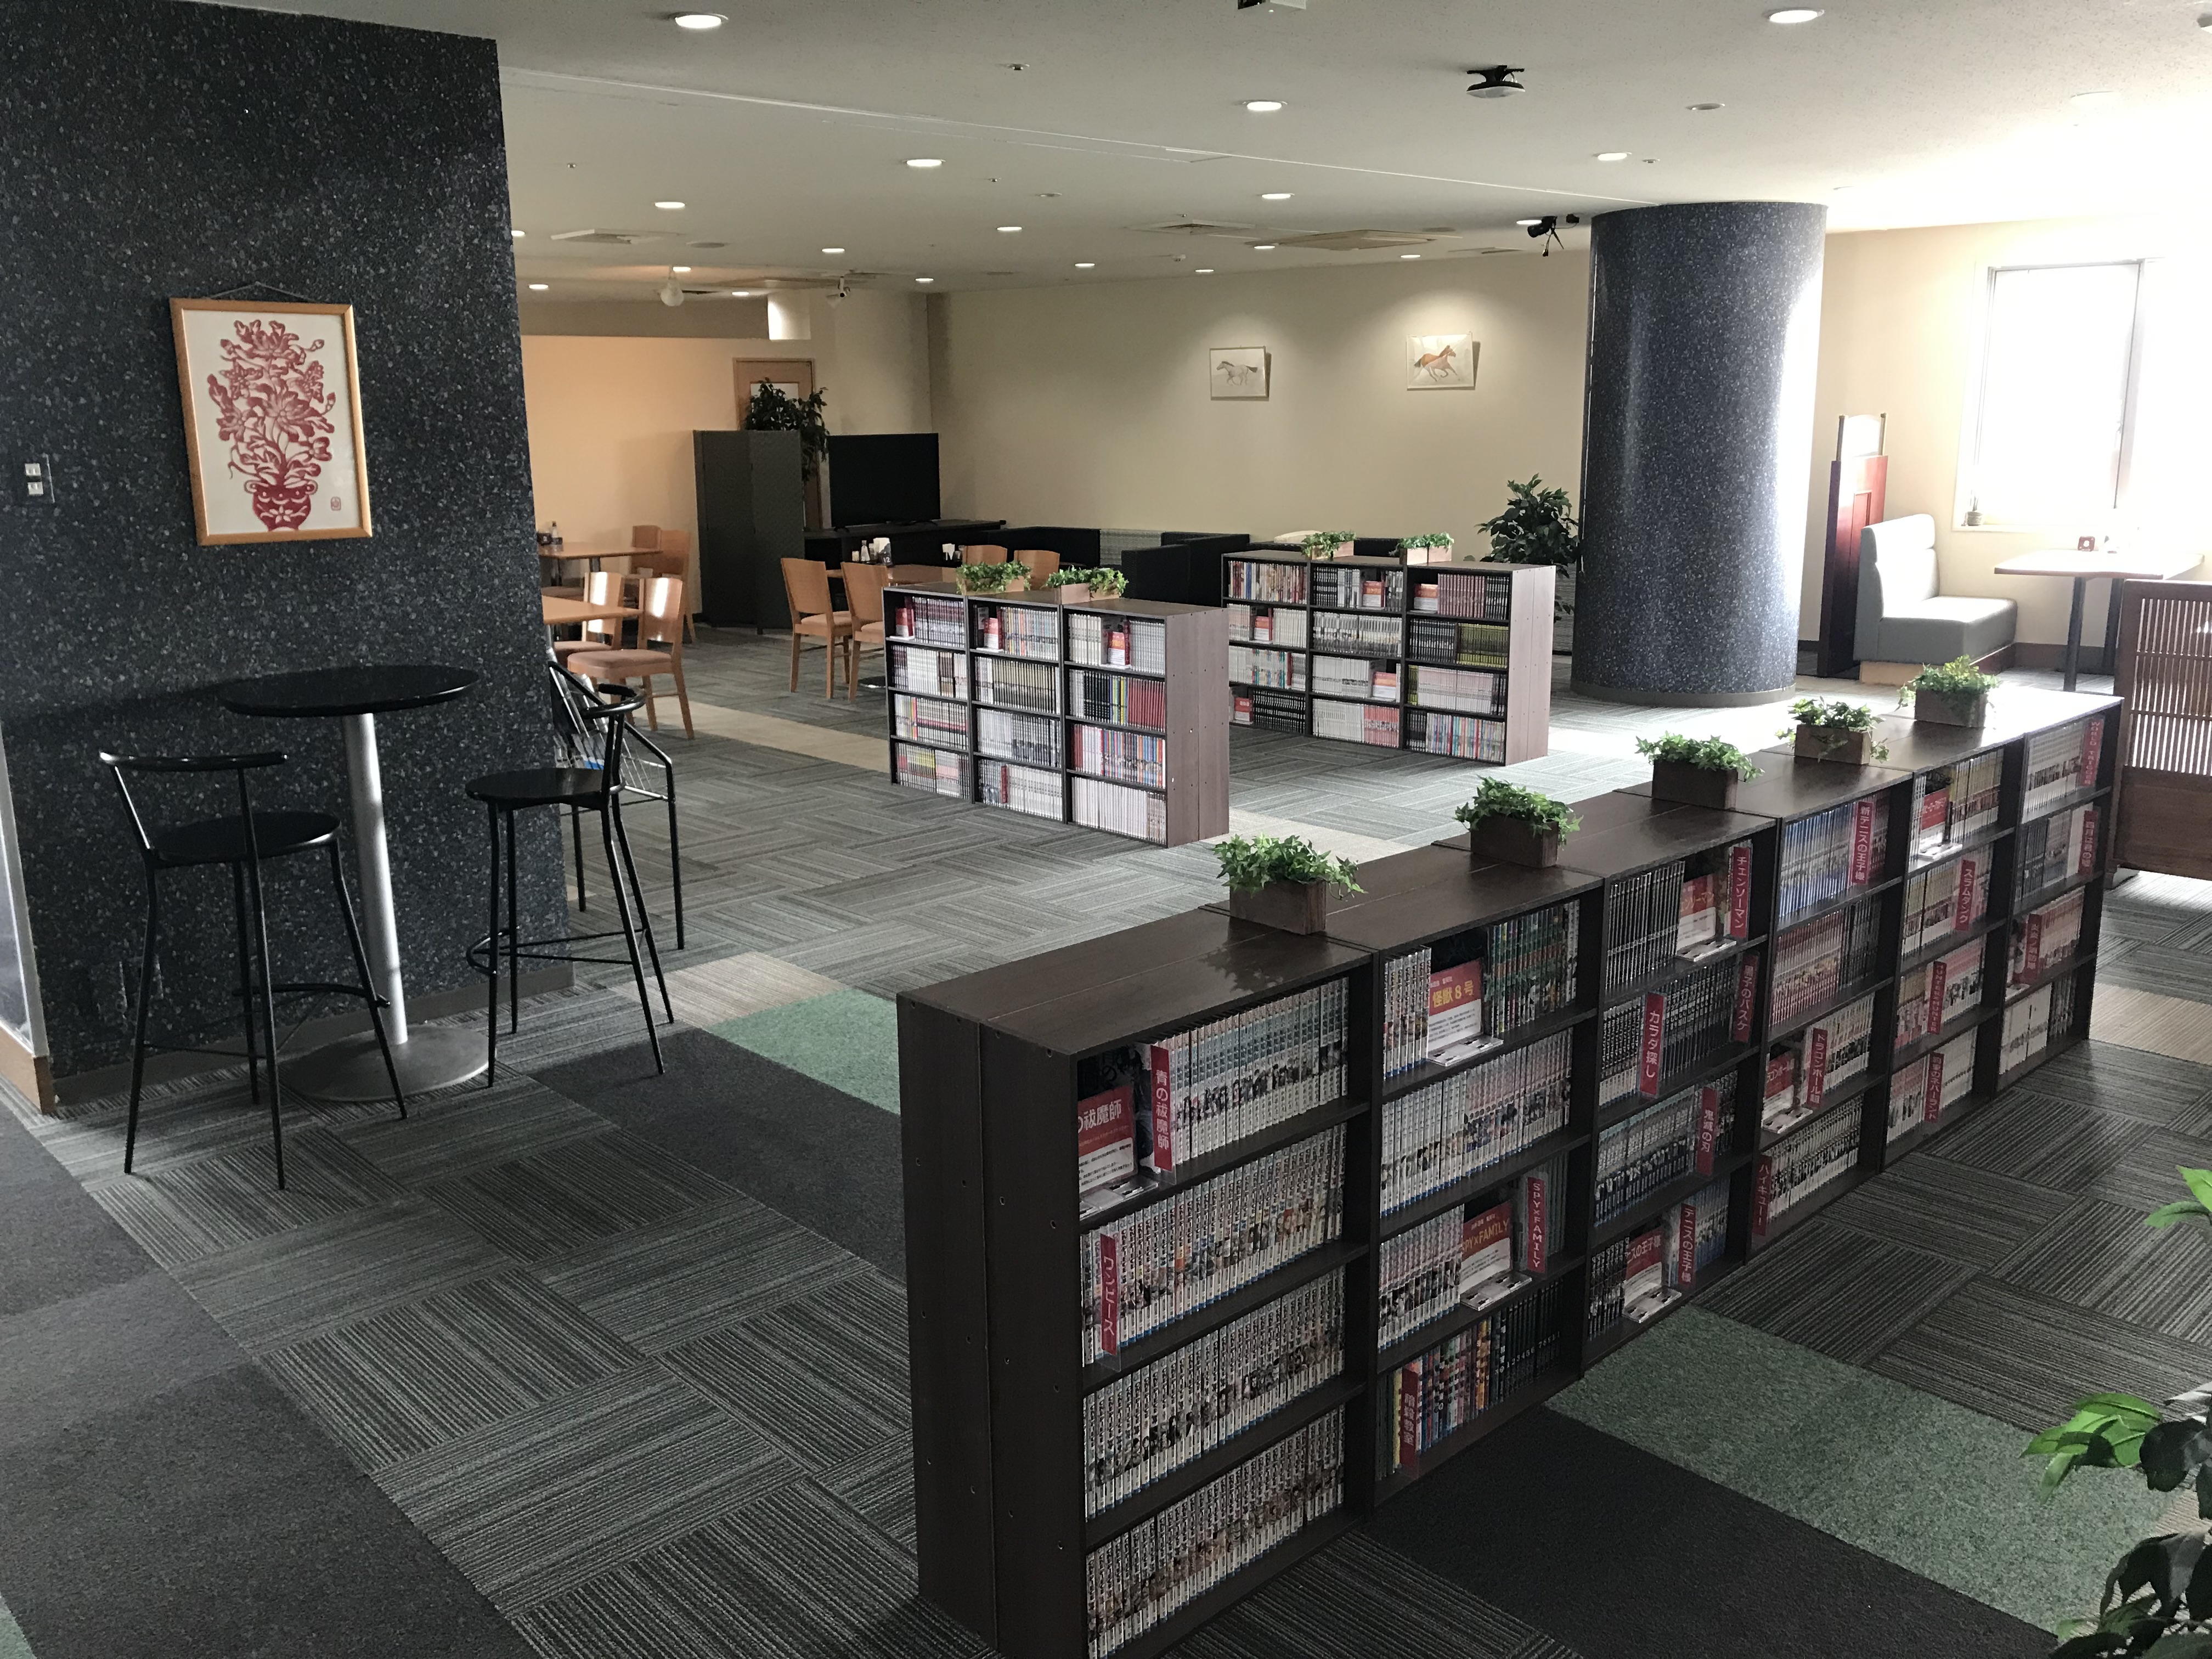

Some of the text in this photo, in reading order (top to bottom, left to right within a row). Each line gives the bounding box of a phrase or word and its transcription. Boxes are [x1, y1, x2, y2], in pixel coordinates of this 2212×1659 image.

[1855, 806, 1870, 881] 新テニスの王子様
[1959, 869, 1972, 923] スラムダンク
[1646, 1011, 1660, 1078] カラダ探し
[1155, 1070, 1170, 1150] 青の祓魔師
[1681, 1208, 1694, 1282] テニスの王子様
[1103, 1256, 1115, 1336] ワンピース
